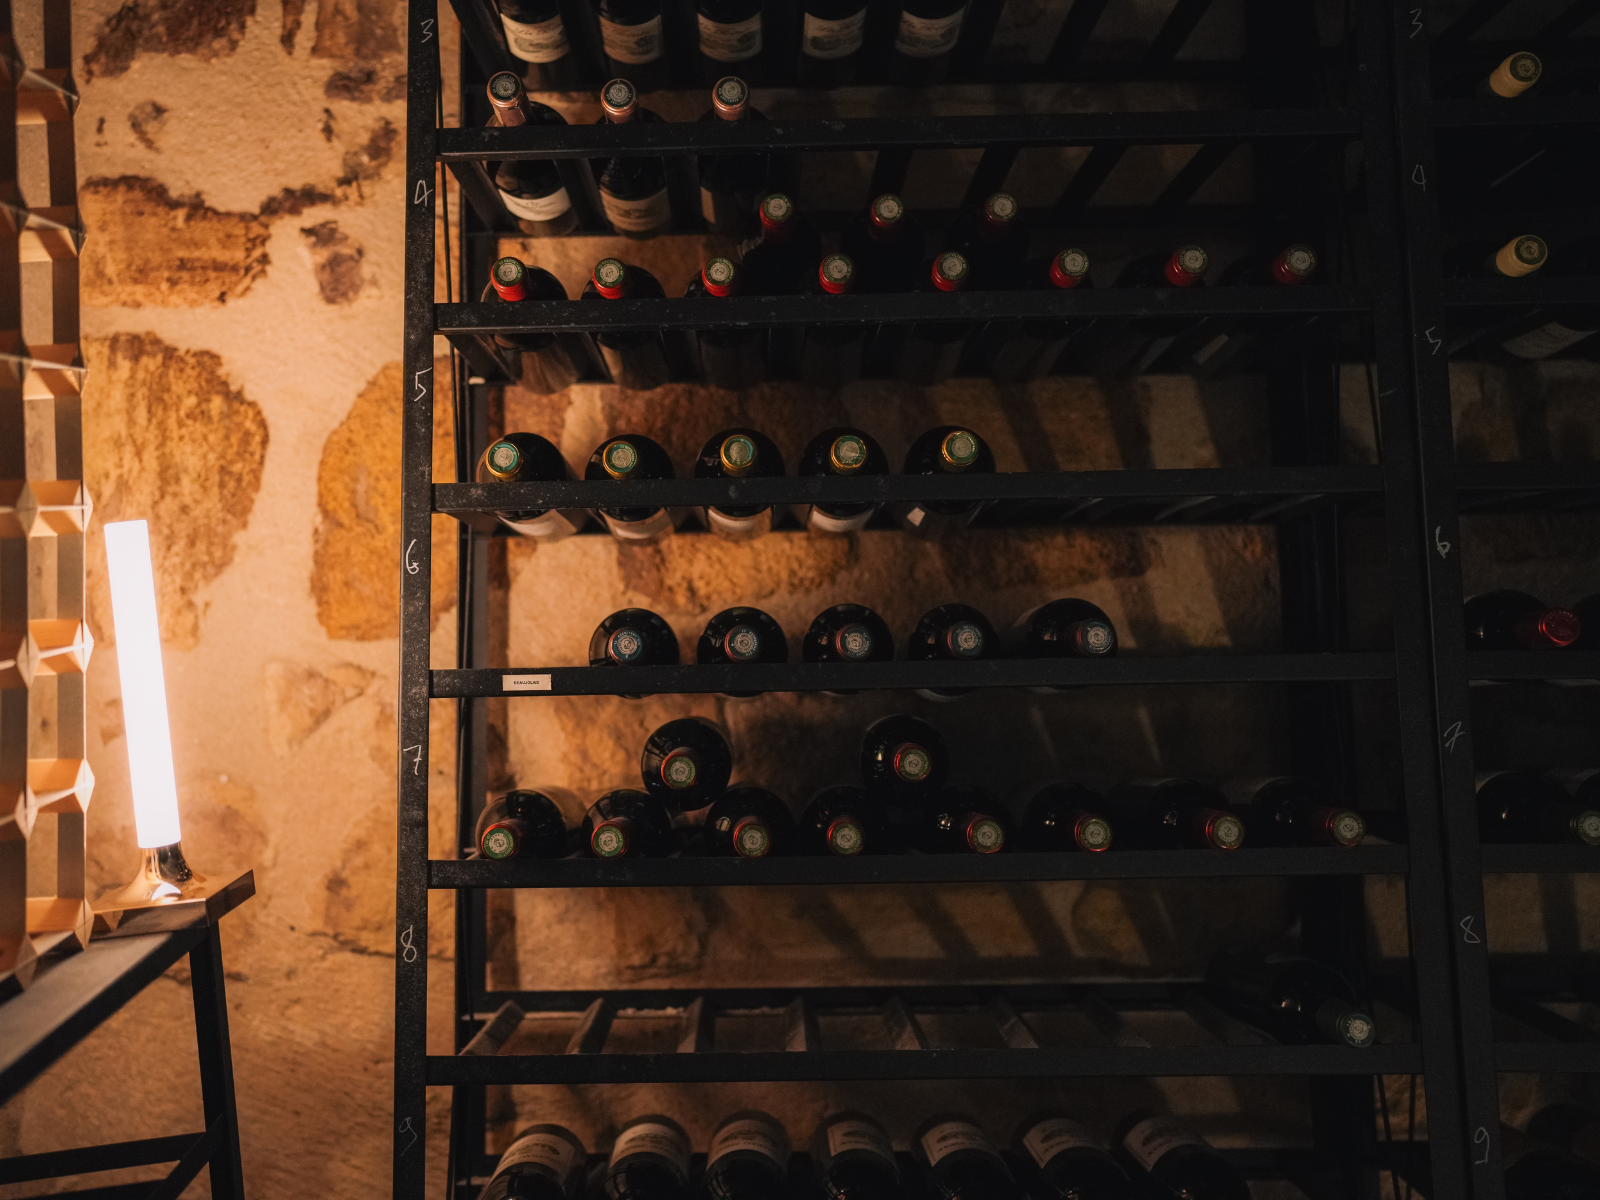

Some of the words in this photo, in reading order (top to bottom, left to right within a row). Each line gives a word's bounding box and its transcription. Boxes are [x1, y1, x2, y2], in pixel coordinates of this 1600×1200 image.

[420, 18, 434, 43] 3
[1409, 8, 1423, 38] 3
[413, 179, 434, 207] 4
[1412, 164, 1428, 192] 4
[1424, 325, 1442, 355] 5
[413, 366, 433, 402] 5
[405, 538, 419, 575] 6
[1435, 525, 1451, 559] 6
[1443, 720, 1466, 755] 7
[402, 744, 423, 776] 7
[400, 924, 417, 963] 8
[1460, 915, 1481, 944] 8
[398, 1116, 418, 1157] 9
[1474, 1126, 1490, 1165] 9
